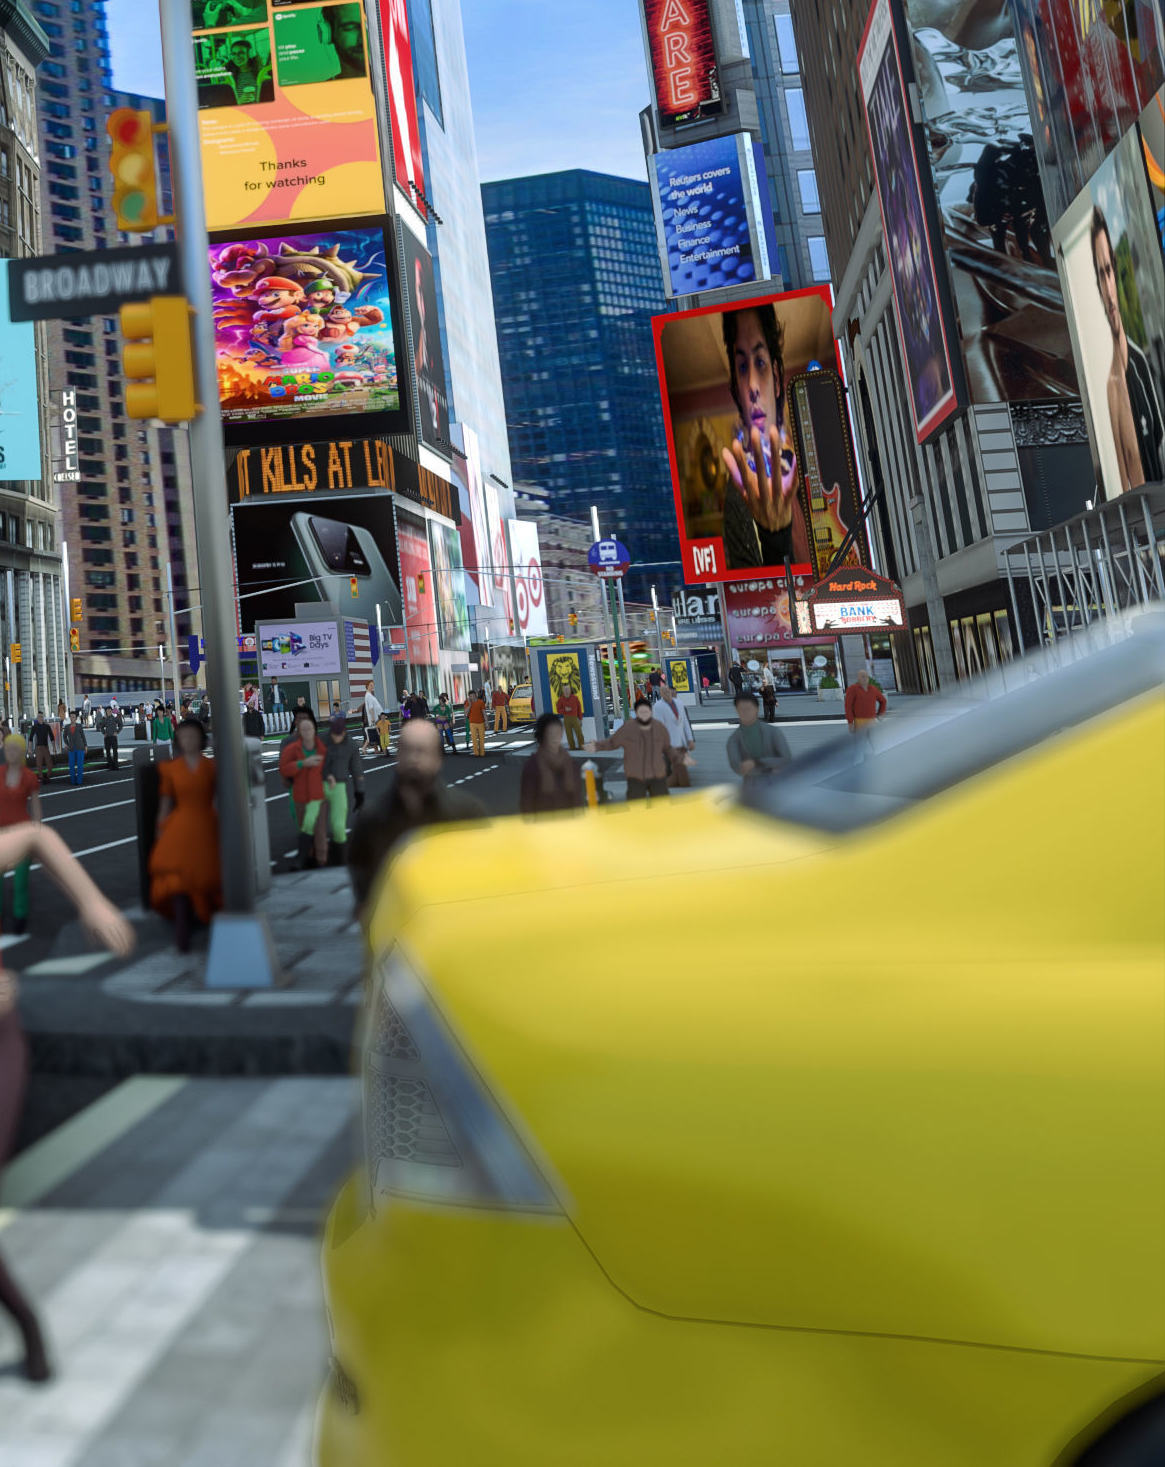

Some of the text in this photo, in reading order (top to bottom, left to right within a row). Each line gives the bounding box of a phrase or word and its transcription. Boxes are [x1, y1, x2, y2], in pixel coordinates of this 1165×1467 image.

[259, 159, 308, 172] Thanks
[244, 174, 326, 191] for watching
[669, 166, 731, 188] Reuters covers
[670, 182, 713, 201] the world
[673, 205, 699, 218] News
[676, 220, 712, 235] Business
[677, 236, 711, 250] Finance
[679, 244, 740, 265] Entertainment
[22, 256, 172, 305] BROADWAY
[282, 366, 320, 375] SUPER
[262, 371, 335, 387] MARIO
[293, 393, 329, 402] MOVIE
[62, 391, 77, 471] HOTEL
[260, 443, 318, 494] KILLS
[327, 441, 353, 489] AT
[729, 580, 774, 594] europa
[828, 579, 878, 592] Hard Rock
[732, 605, 776, 619] europa
[840, 605, 875, 618] BANK
[309, 633, 333, 643] Big TV
[735, 632, 780, 644] europa
[309, 641, 330, 650] Days
[587, 654, 600, 700] Newsstand
